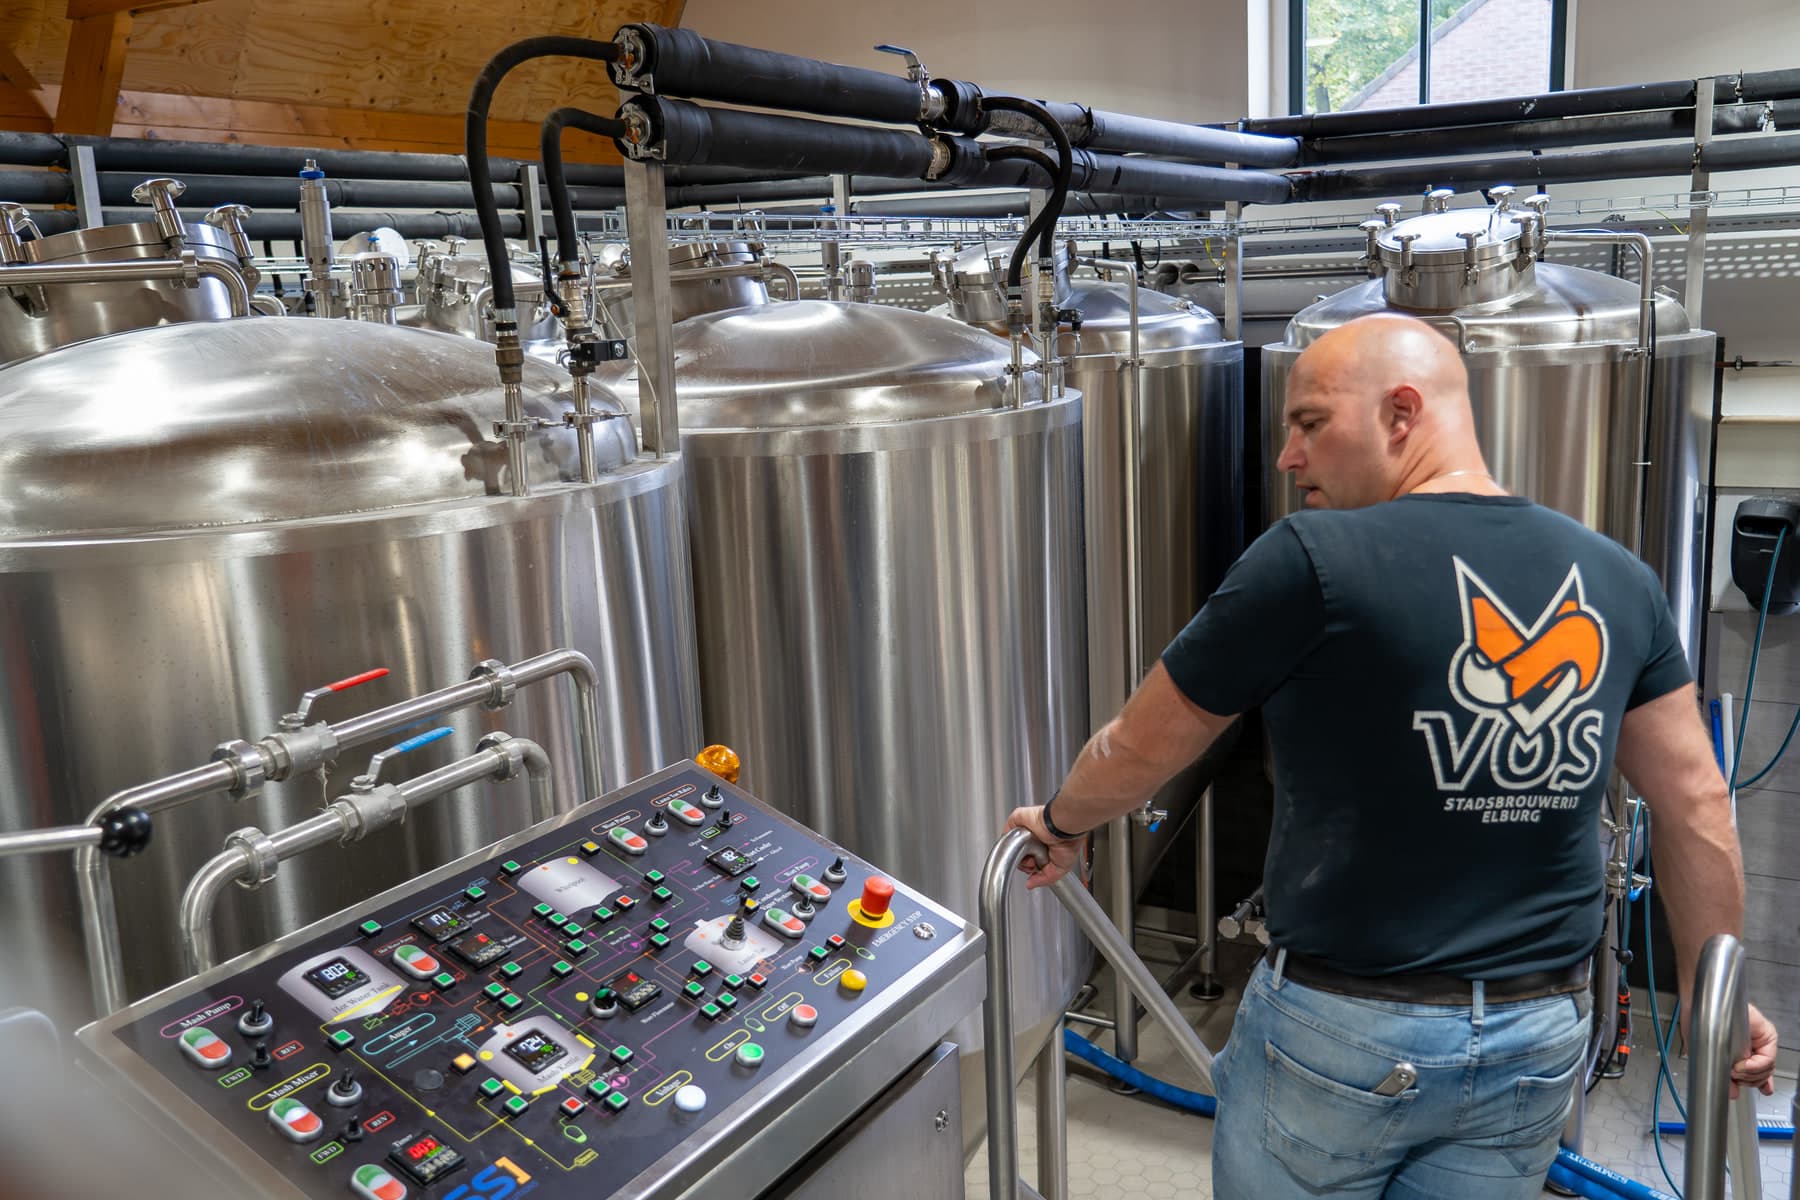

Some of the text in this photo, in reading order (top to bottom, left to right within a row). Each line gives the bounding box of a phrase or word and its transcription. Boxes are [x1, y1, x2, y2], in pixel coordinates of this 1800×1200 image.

[1413, 709, 1604, 792] VOS
[1443, 794, 1580, 812] STADSBROUWERIJ
[1481, 808, 1543, 824] ELBURG
[872, 911, 922, 947] EMERGENCY STOP
[180, 1003, 231, 1027] Mash Pump
[389, 1026, 412, 1041] Auger
[225, 1072, 244, 1083] FWD
[267, 1071, 318, 1099] Mash Mixer
[655, 1079, 682, 1096] Voltage
[372, 1117, 387, 1127] REV
[317, 1146, 336, 1159] FWD
